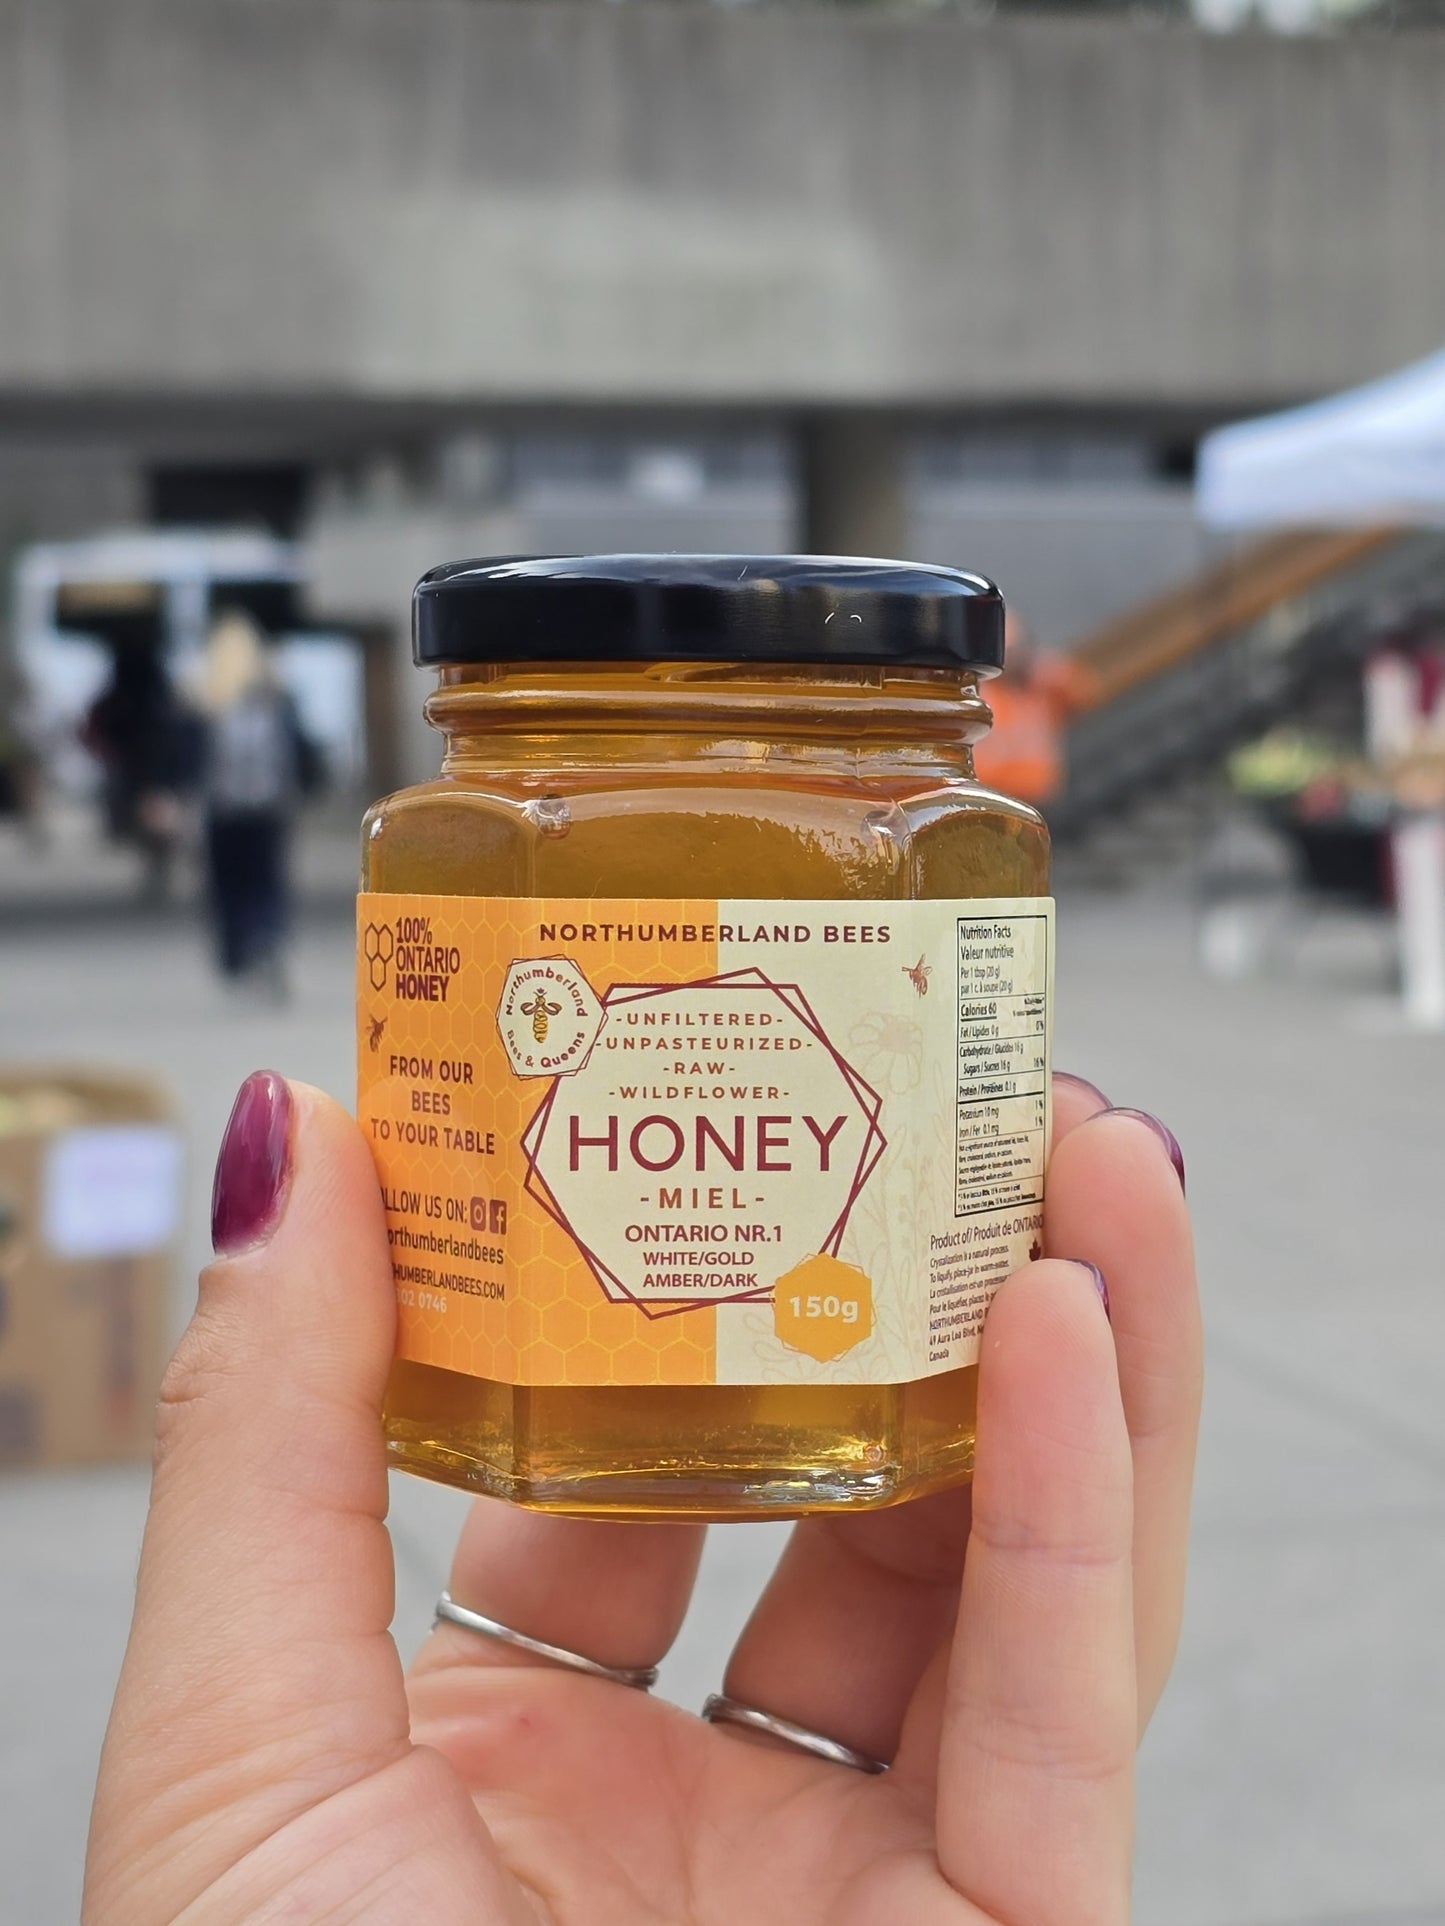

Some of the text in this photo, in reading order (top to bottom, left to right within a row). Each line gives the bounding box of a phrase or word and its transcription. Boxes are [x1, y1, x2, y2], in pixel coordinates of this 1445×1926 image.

[396, 916, 432, 944] 100%
[539, 924, 891, 943] NORTHUMBERLAND BEES
[960, 924, 1011, 940] Nutrition Facts
[396, 946, 460, 975] ONTARIO
[960, 944, 1014, 960] Valeur nutritive
[396, 974, 449, 1002] HONEY
[506, 966, 588, 1017] Northumberland
[960, 1003, 988, 1017] Calories
[988, 1002, 997, 1015] 60
[507, 1030, 585, 1068] Bees & Queens
[390, 1055, 473, 1084] FROM OUR
[412, 1090, 451, 1115] BEES
[371, 1118, 495, 1155] TO YOUR TABLE
[569, 1115, 848, 1172] HONEY
[425, 1195, 442, 1219] US
[446, 1198, 468, 1224] ON:
[625, 1225, 782, 1243] ONTARIO NR.1
[930, 1231, 960, 1250] Product
[974, 1223, 1001, 1242] Produit
[1002, 1220, 1011, 1236] de
[643, 1251, 754, 1266] WHITE/GOLD
[642, 1273, 758, 1288] AMBER/DARK
[397, 1288, 447, 1313] 02 0746
[789, 1296, 858, 1323] 150g
[929, 1349, 949, 1362] Canada
